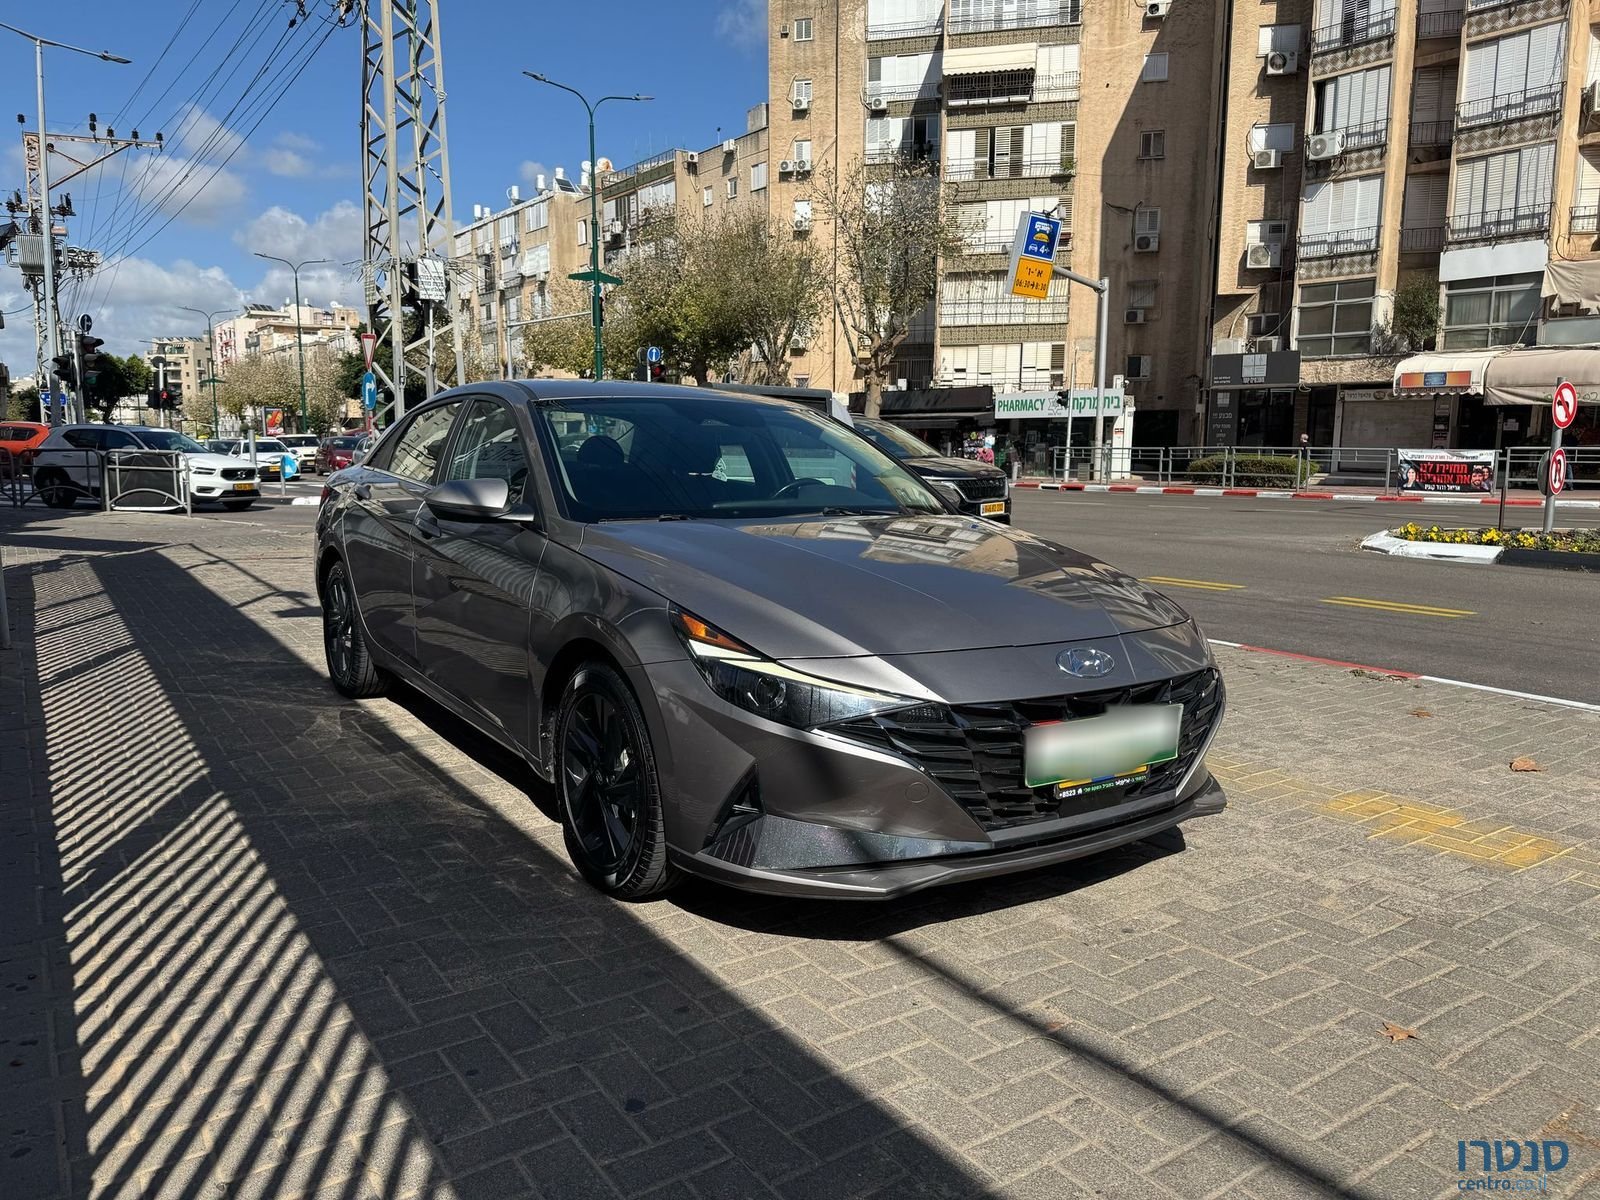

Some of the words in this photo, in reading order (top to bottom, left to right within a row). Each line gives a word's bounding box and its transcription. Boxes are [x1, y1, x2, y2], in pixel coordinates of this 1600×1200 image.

[997, 398, 1046, 412] PHARMACY
[1071, 396, 1099, 414] מרקח
[1103, 395, 1121, 409] בית
[1419, 461, 1434, 474] לנו
[1436, 463, 1468, 474] תחזירו
[1456, 473, 1471, 485] את
